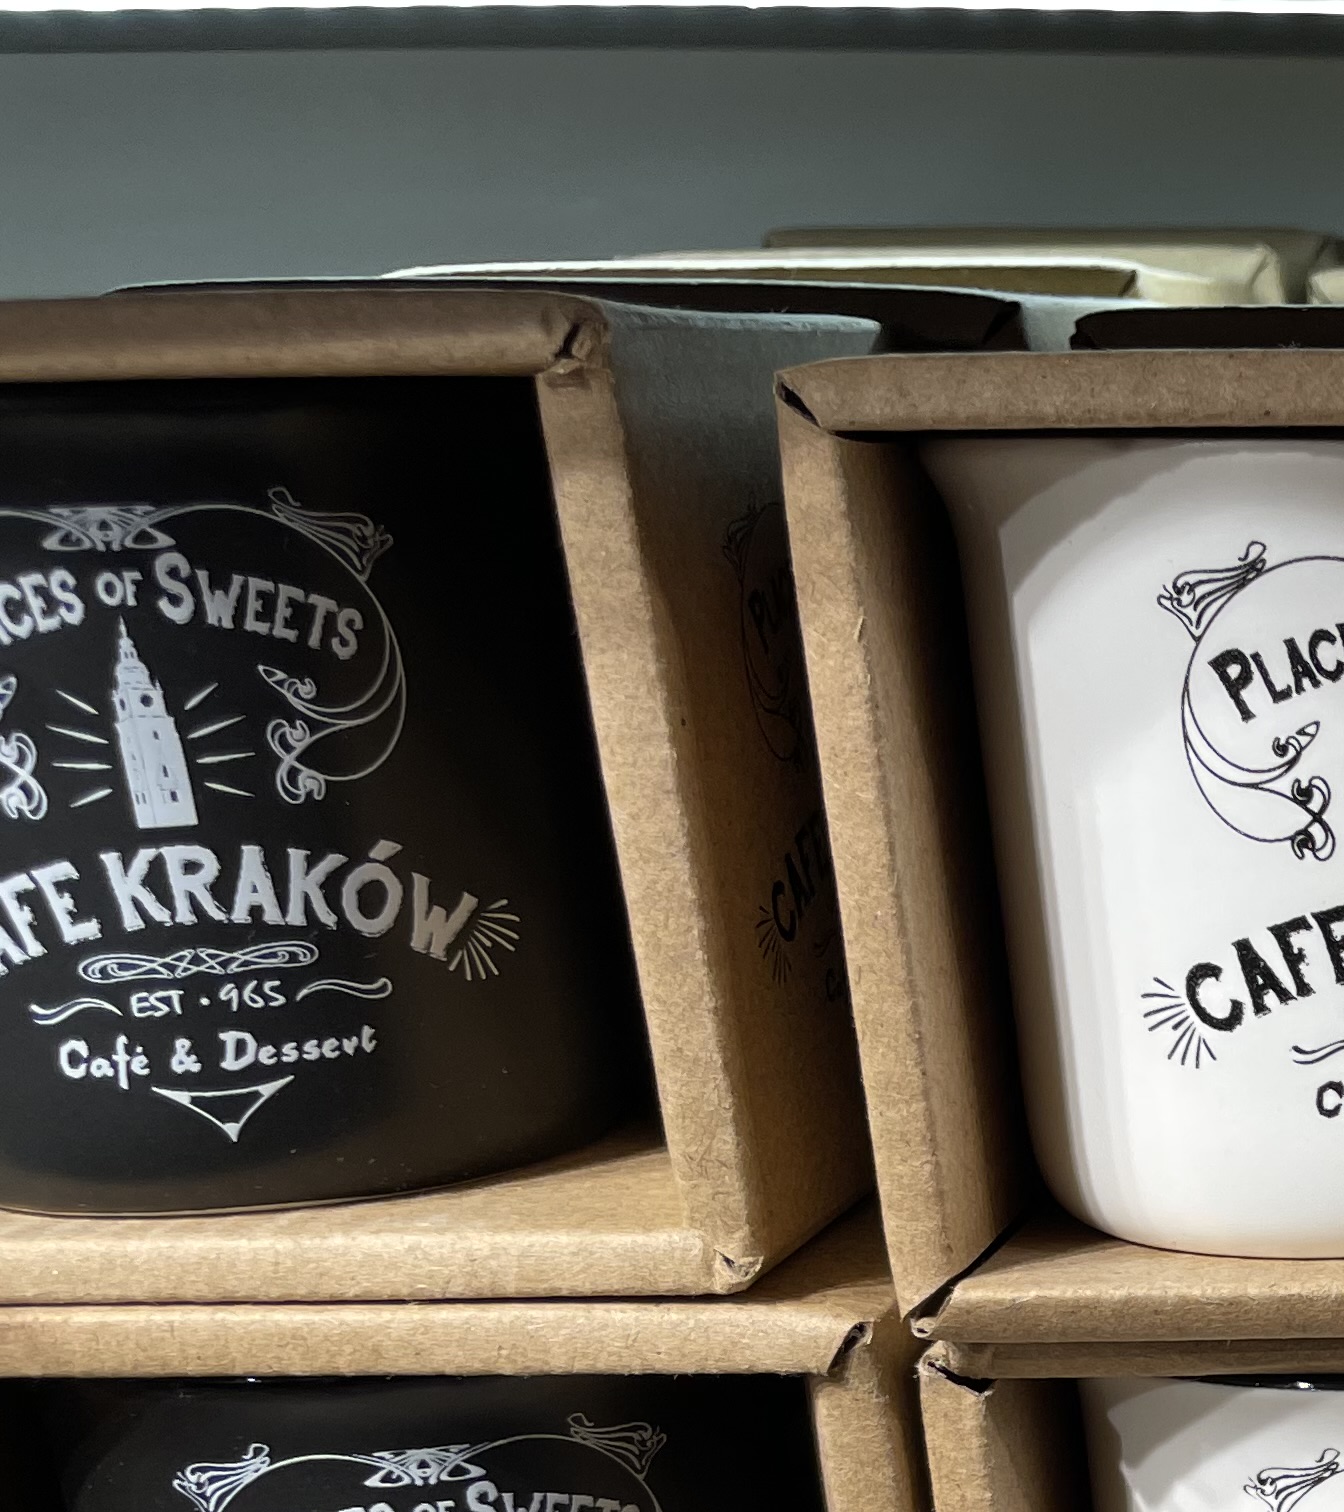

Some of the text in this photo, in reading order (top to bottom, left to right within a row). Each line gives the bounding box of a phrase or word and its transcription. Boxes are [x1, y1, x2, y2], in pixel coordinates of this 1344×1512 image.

[0, 552, 364, 660] CES OF SWEETS
[100, 839, 478, 961] KRAKÓW
[220, 979, 288, 1012] 965
[59, 1024, 377, 1090] Café & Dessert
